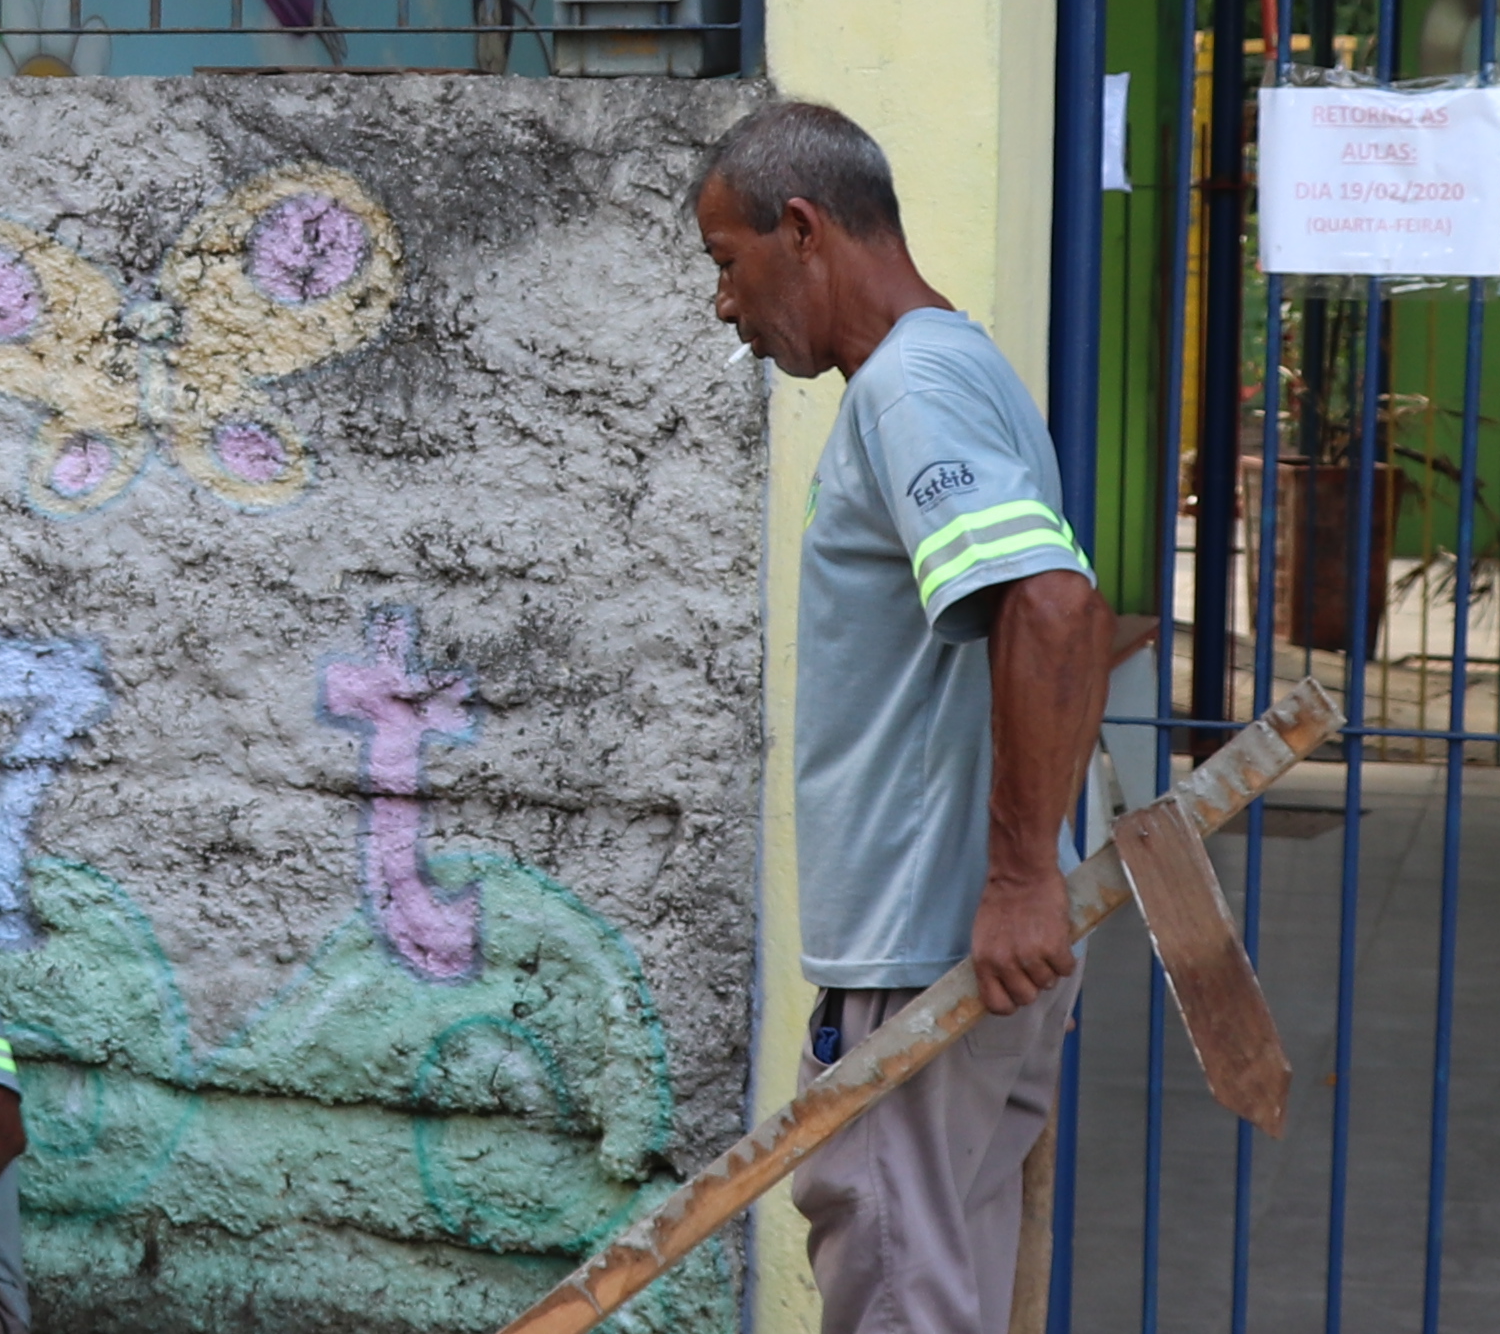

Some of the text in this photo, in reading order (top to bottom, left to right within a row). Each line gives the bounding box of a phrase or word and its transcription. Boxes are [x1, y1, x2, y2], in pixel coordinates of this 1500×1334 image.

[1311, 105, 1449, 124] RETORNO AS
[1341, 142, 1418, 162] AULAS:
[1294, 181, 1466, 204] DIA 19/02/2020
[1306, 216, 1453, 236] (QUARTA-FEIRA)
[913, 464, 975, 507] Esteio
